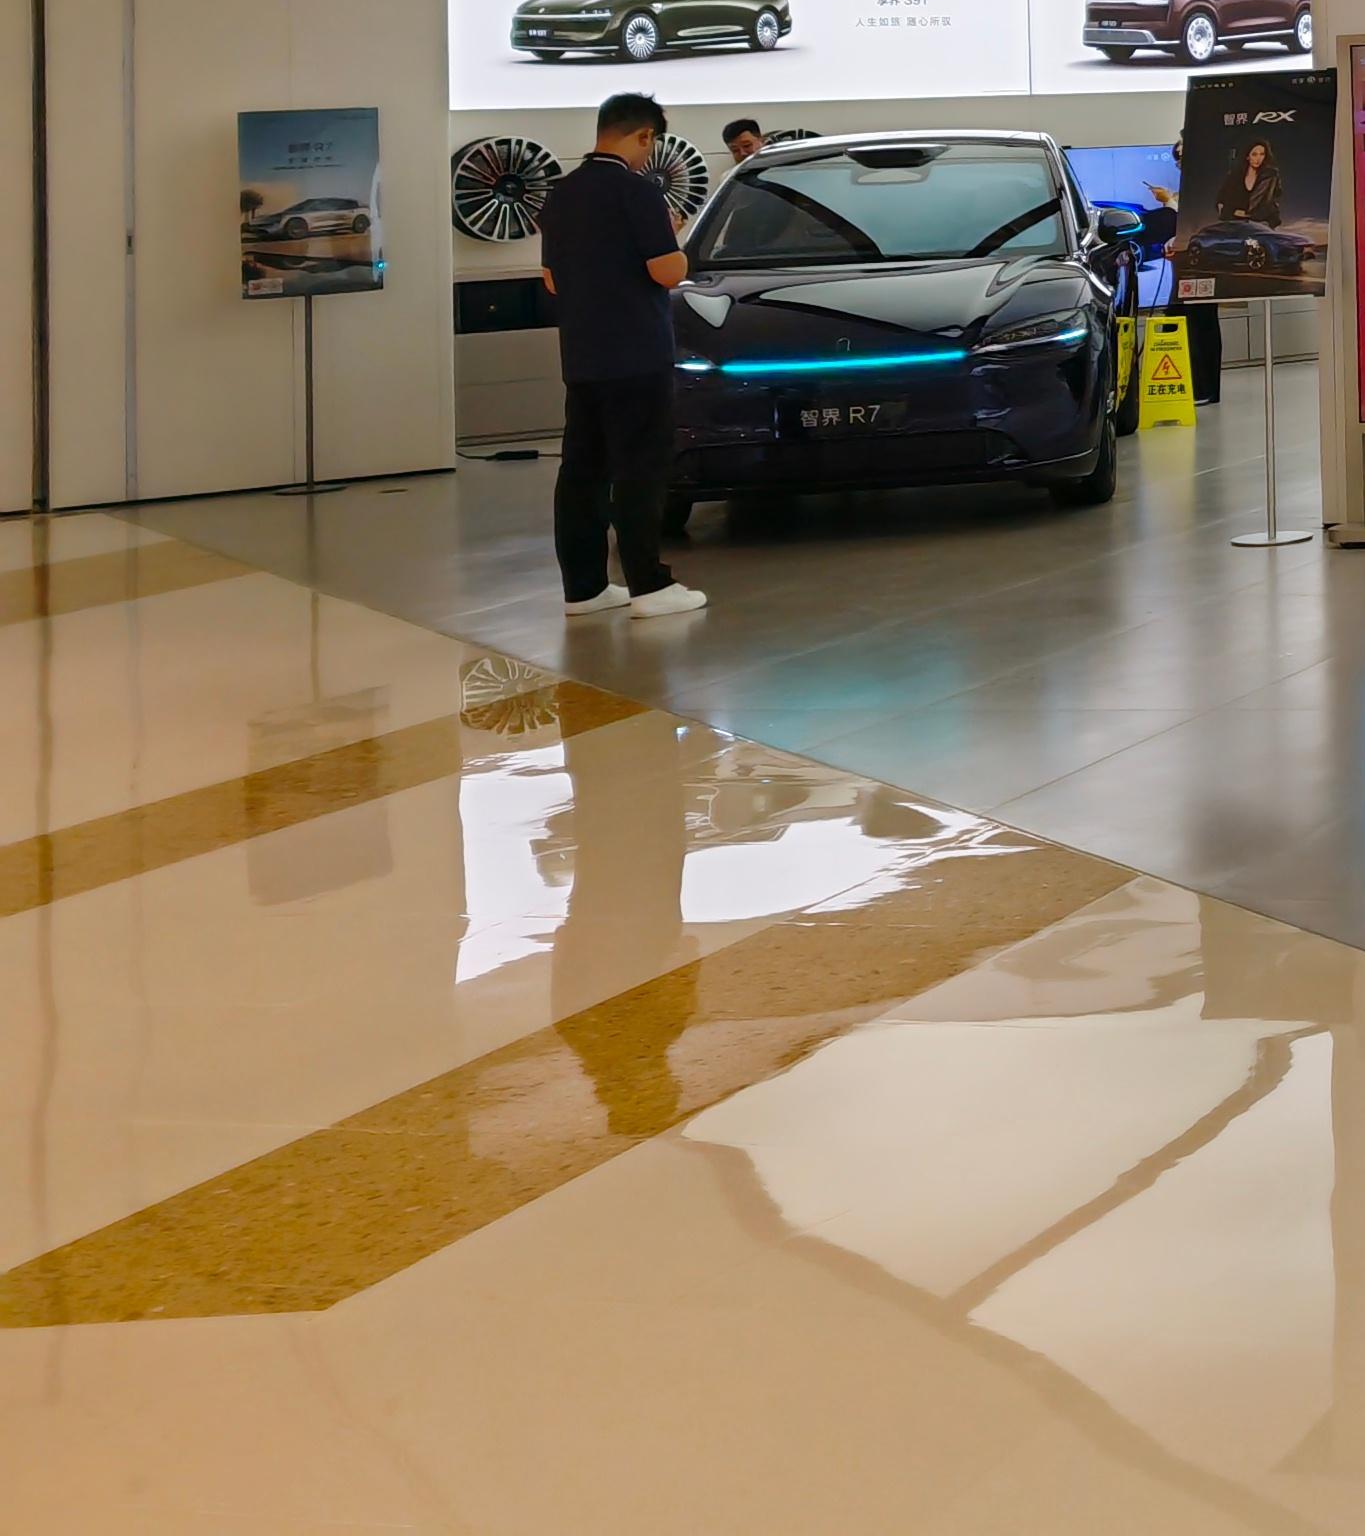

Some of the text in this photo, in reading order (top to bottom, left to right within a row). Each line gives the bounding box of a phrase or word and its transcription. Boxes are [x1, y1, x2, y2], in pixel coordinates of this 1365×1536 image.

[1223, 113, 1248, 125] 智界
[1147, 384, 1186, 396] 正在充电
[800, 404, 881, 428] 智界 R7
